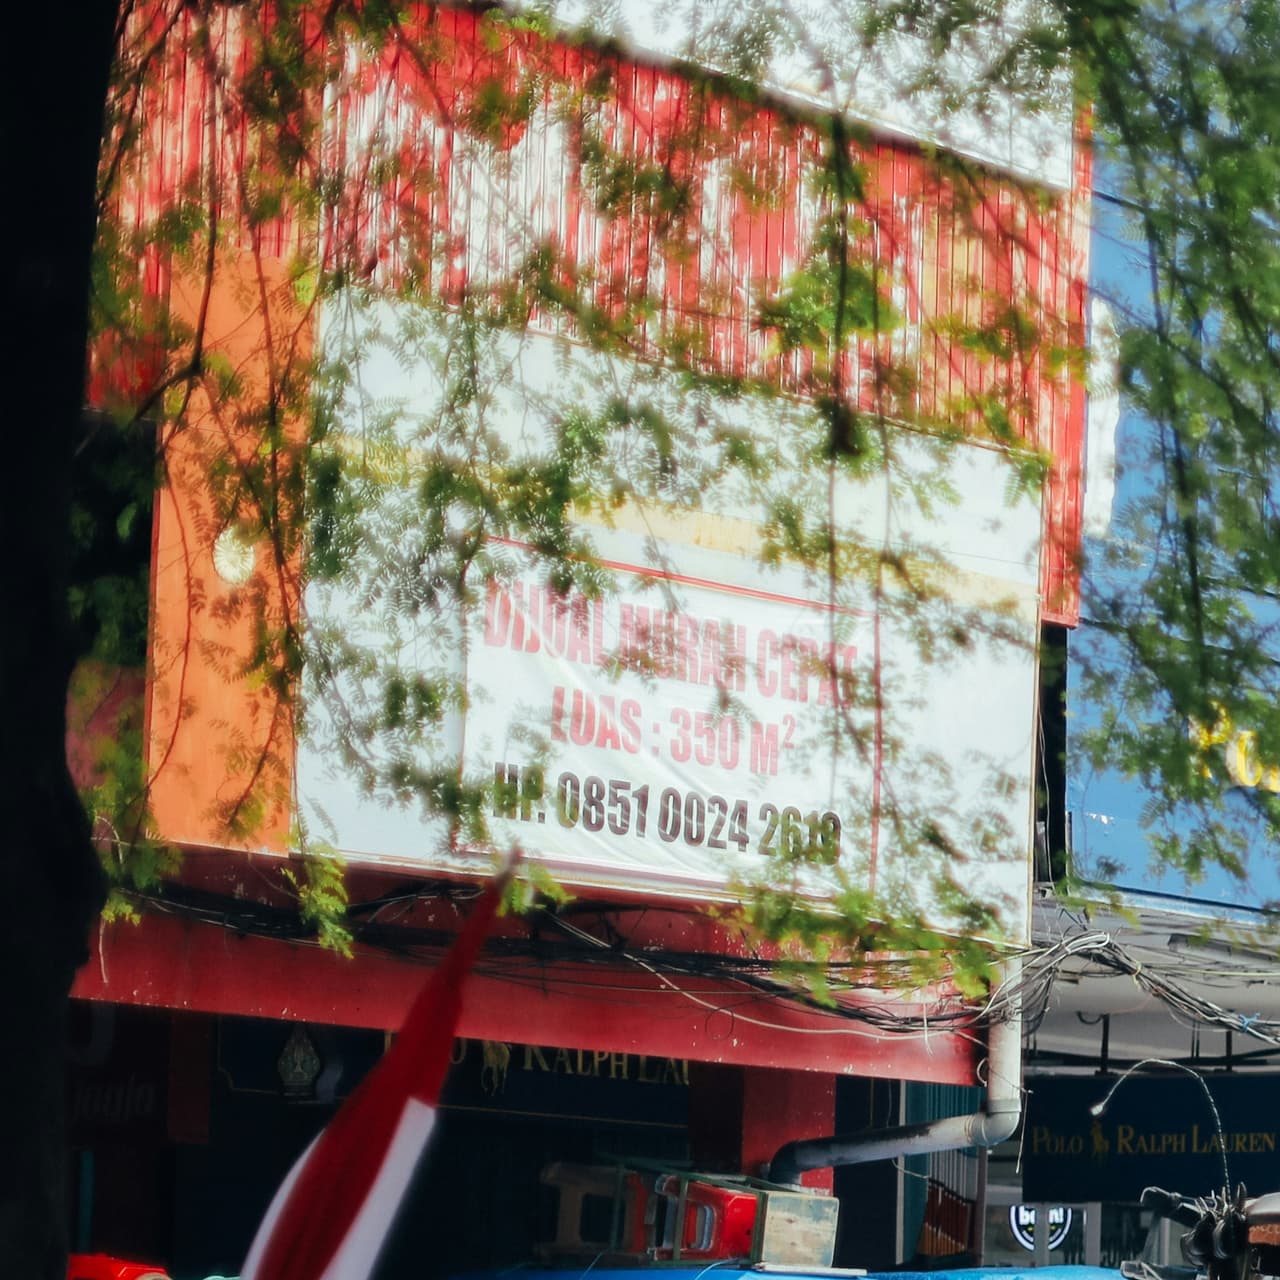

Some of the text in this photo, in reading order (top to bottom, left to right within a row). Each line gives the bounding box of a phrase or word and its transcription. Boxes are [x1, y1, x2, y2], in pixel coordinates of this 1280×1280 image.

[551, 686, 642, 755] LUAS
[670, 706, 741, 770] 350
[557, 771, 651, 838] 0851
[657, 785, 750, 853] 0024
[1031, 1123, 1277, 1155] POLO RALPH LAUREN
